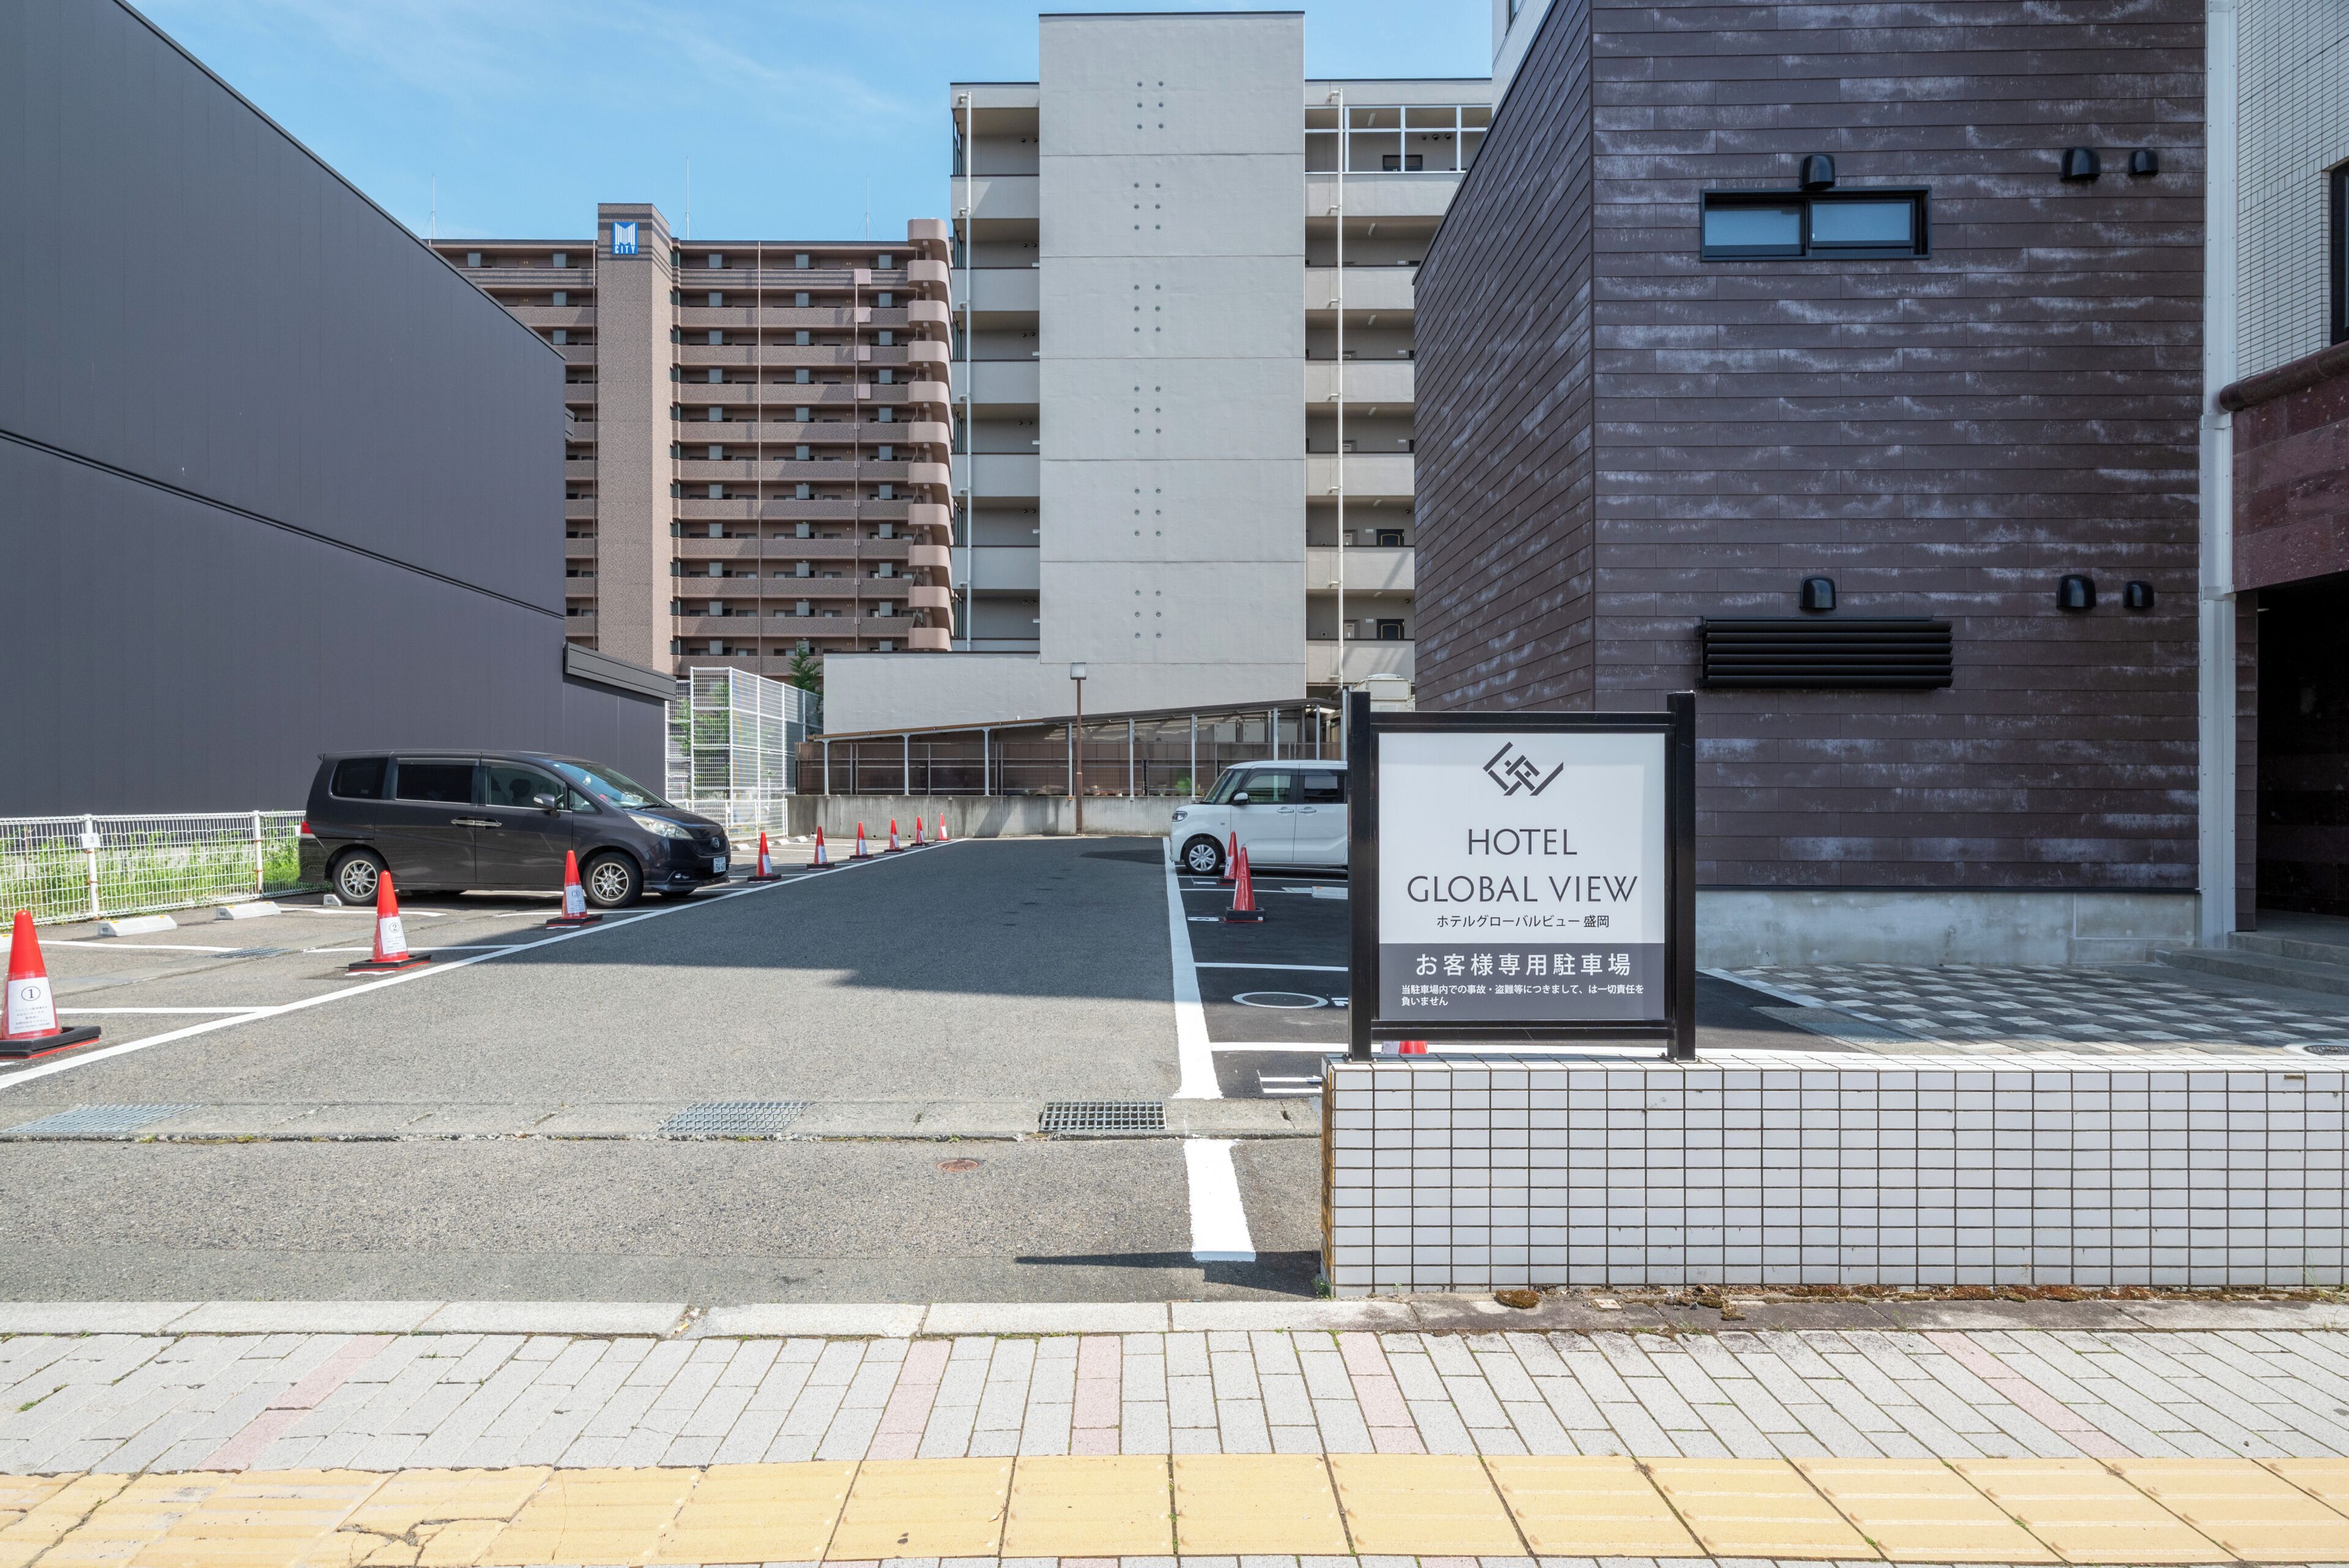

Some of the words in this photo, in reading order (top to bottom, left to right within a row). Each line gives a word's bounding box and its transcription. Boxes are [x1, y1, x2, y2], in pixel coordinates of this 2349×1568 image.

[615, 245, 636, 254] CITY
[1468, 828, 1578, 855] HOTEL
[1407, 875, 1538, 902] GLOBAL
[1548, 875, 1638, 902] VIEW
[1416, 953, 1631, 976] お客様専用駐車場
[1401, 984, 1644, 995] 当駐車場内での事故・盗難等につきまして、は一切責任を
[1401, 996, 1449, 1006] 負いません
